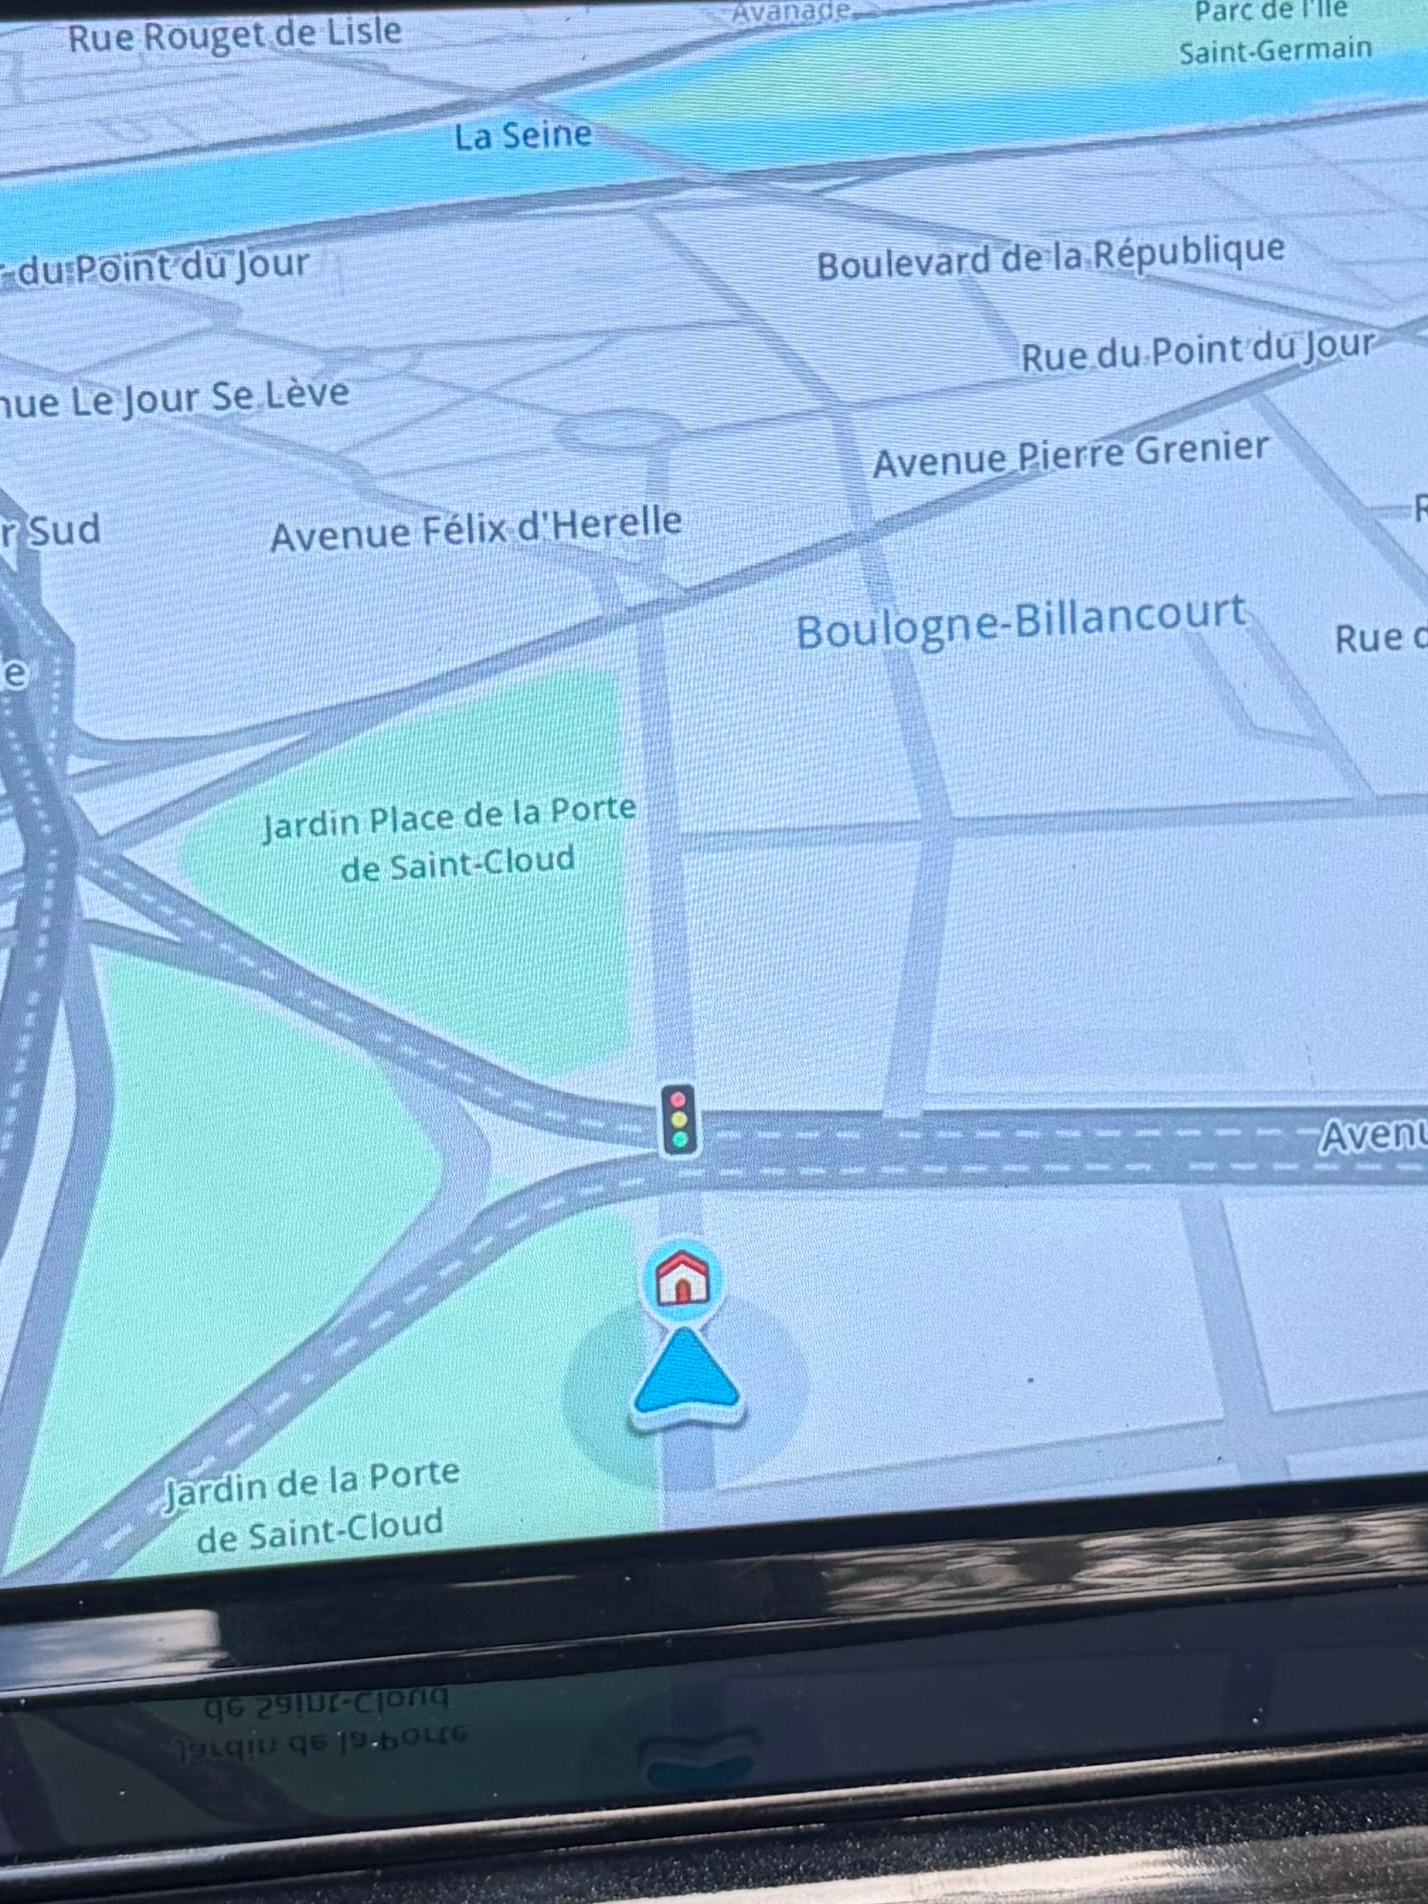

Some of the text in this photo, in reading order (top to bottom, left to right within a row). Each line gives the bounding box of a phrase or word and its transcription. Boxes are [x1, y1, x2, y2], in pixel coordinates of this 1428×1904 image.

[731, 0, 852, 24] Avanade
[1195, 0, 1254, 23] Parc
[69, 16, 403, 56] Rue Rouget de Lisle
[1178, 34, 1373, 67] Saint-Germain
[456, 119, 592, 152] La Seine
[17, 255, 66, 288] du
[77, 251, 170, 284] Point
[181, 249, 227, 280] du
[235, 247, 311, 284] Jour
[818, 232, 1286, 281] Boulevard de la République
[1022, 326, 1377, 374] Rue du Point du Jour
[72, 386, 114, 417] Le
[122, 383, 200, 422] Jour
[212, 380, 254, 411] Se
[266, 376, 351, 409] Lève
[872, 432, 1271, 481] Avenue Pierre Grenier
[30, 512, 101, 548] Sud
[272, 504, 683, 554] Avenue Félix d'Herelle
[797, 593, 1247, 655] Boulogne-Billancourt
[1336, 624, 1403, 656] Rue
[262, 793, 637, 846] Jardin Place de la Porte
[341, 845, 576, 886] de Saint-Cloud
[164, 1459, 462, 1514] Jardin de la Porte
[197, 1507, 445, 1557] de Saint-Cloud
